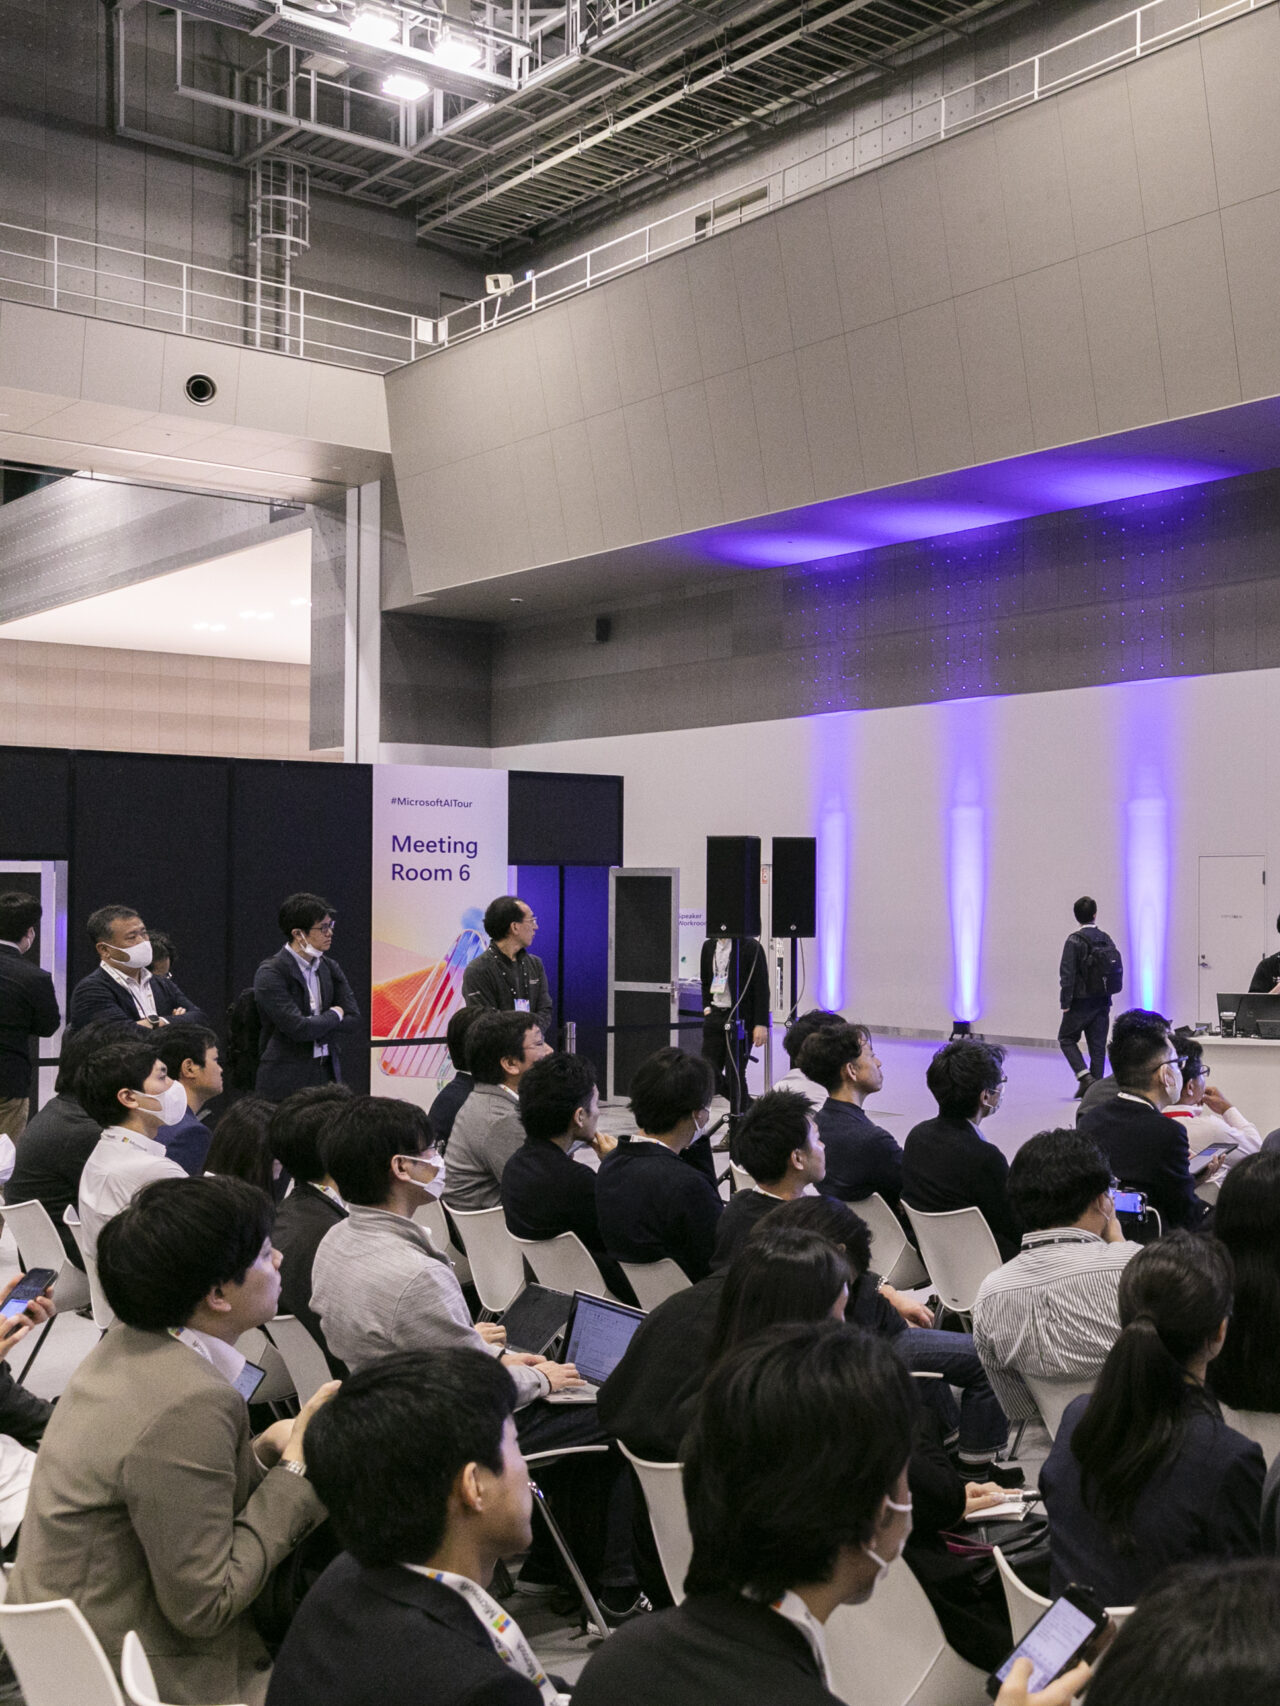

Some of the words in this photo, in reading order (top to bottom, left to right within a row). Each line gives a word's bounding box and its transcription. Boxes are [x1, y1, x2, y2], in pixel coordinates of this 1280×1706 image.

[391, 797, 473, 808] #MicrosoftAITour
[391, 834, 479, 858] Meeting
[391, 863, 453, 881] Room
[459, 864, 471, 881] 6
